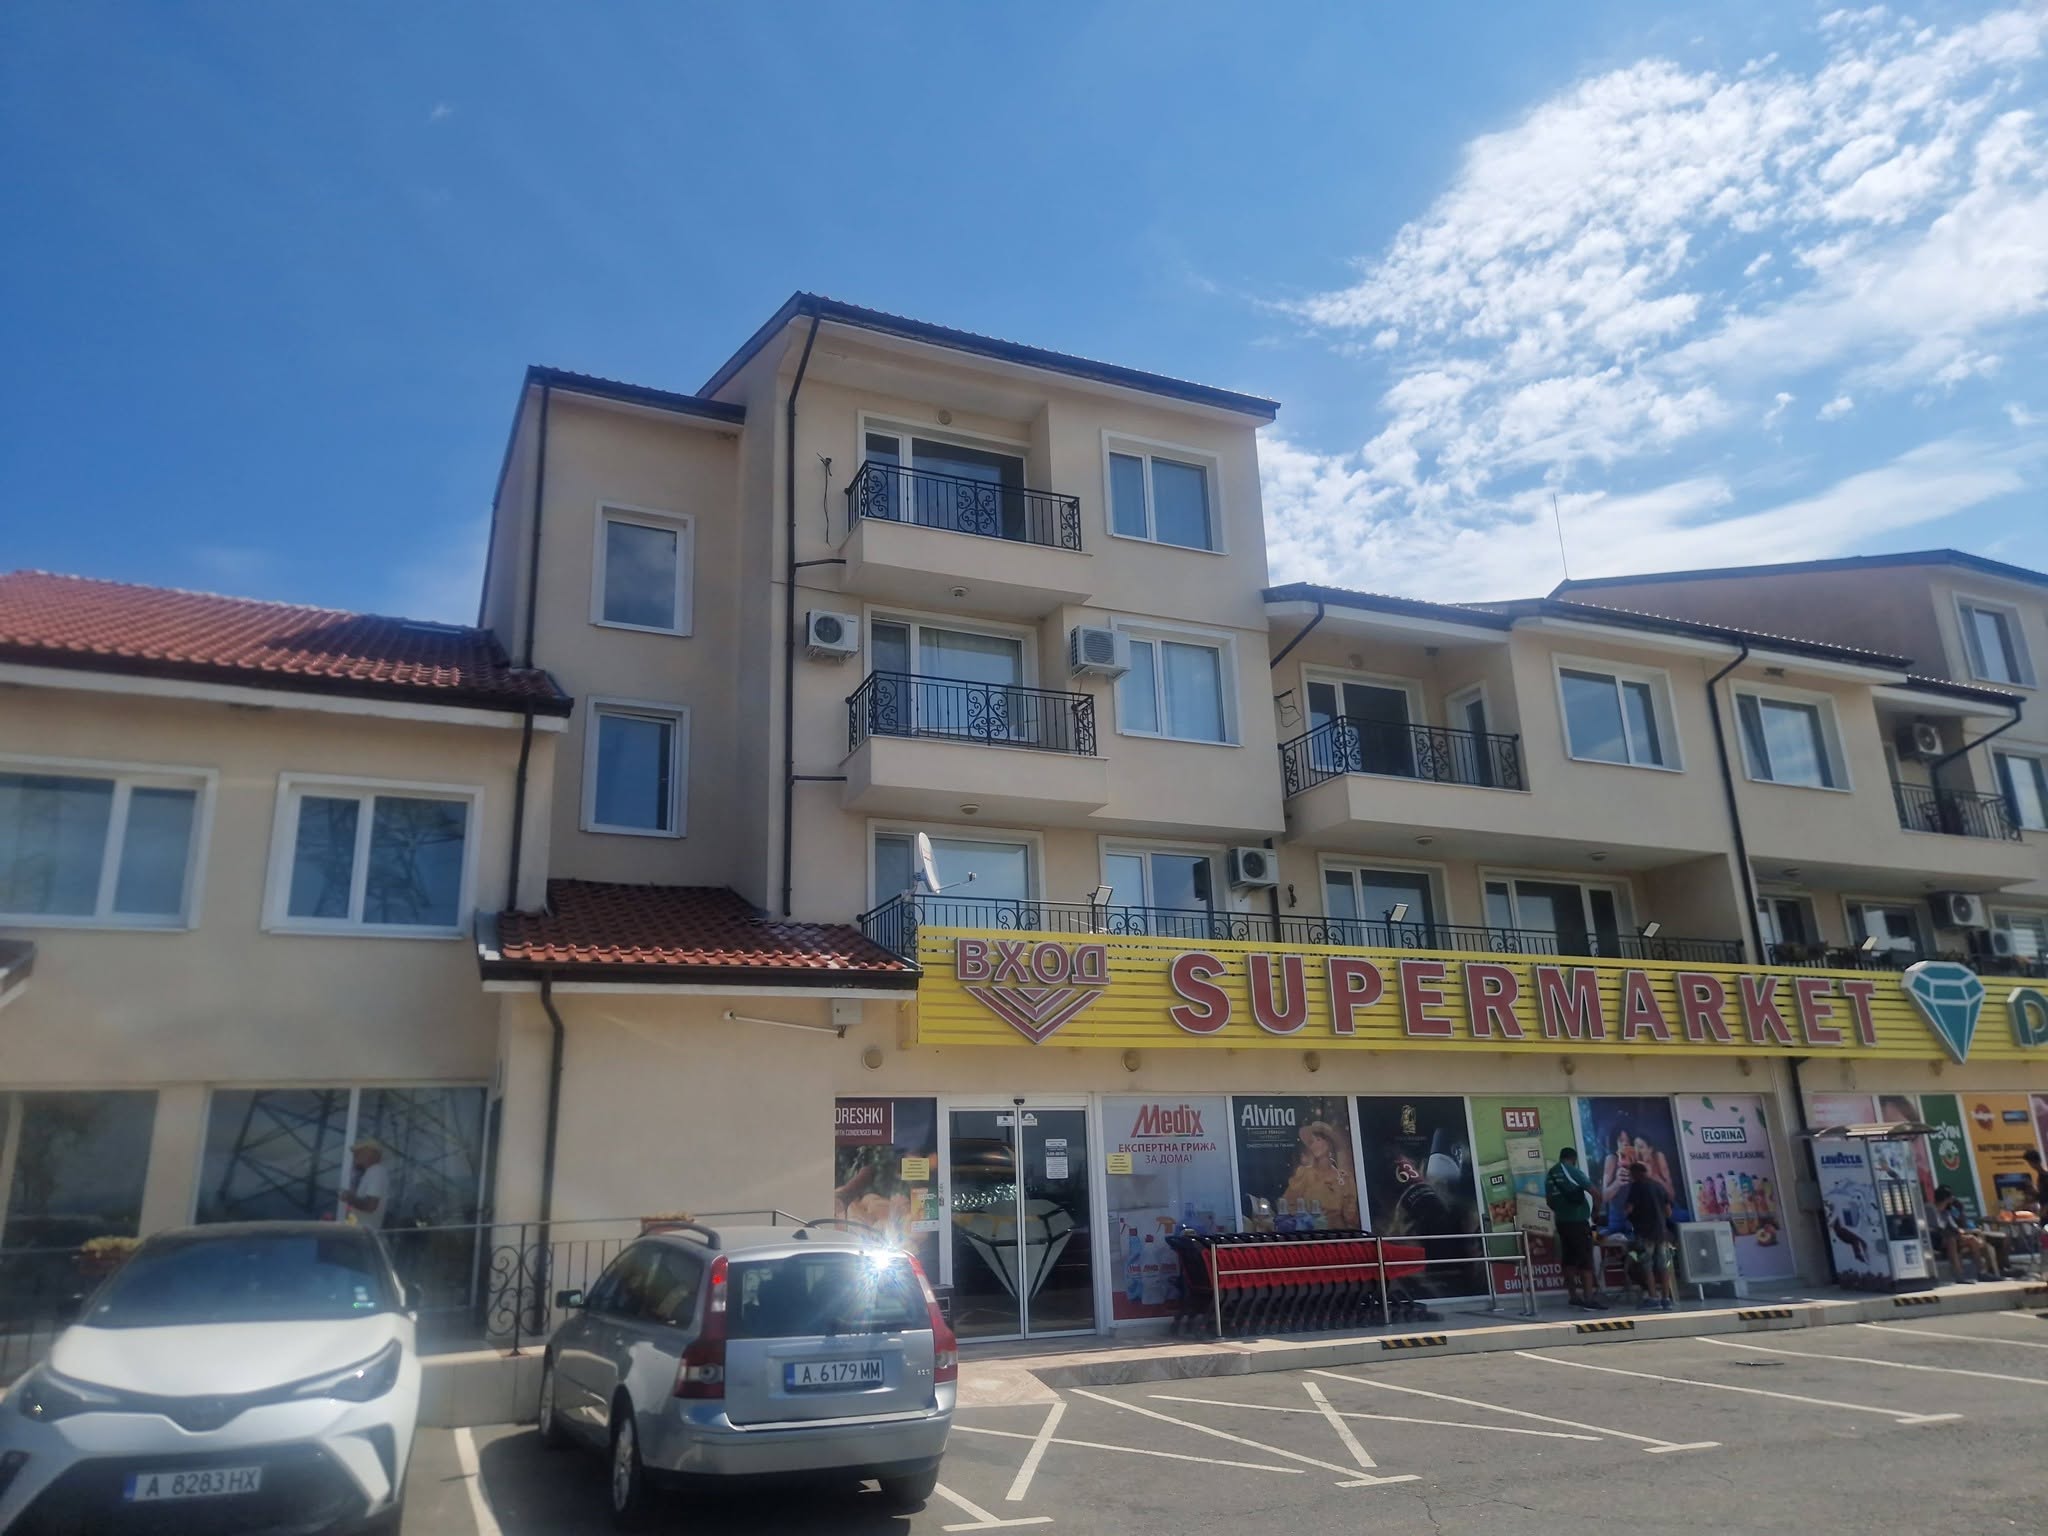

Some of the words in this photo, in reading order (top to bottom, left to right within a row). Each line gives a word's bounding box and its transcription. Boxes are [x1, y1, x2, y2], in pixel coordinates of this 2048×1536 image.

[956, 937, 1110, 985] ВХОД
[1168, 952, 1877, 1047] SUPERMARKET
[835, 1107, 883, 1124] ORESHKI
[1130, 1104, 1204, 1138] Medix
[1241, 1104, 1296, 1127] Alvina
[1704, 1129, 1743, 1141] FLORINA
[1118, 1143, 1180, 1153] ЕКСПЕРТНА
[1181, 1142, 1217, 1152] ГРИЖА
[1689, 1151, 1710, 1160] SHARE
[1712, 1151, 1731, 1159] WITH
[1732, 1151, 1766, 1159] PLEASURE
[1145, 1154, 1157, 1164] ЗА
[1159, 1153, 1193, 1165] ДОМА!
[1395, 1164, 1420, 1183] 63
